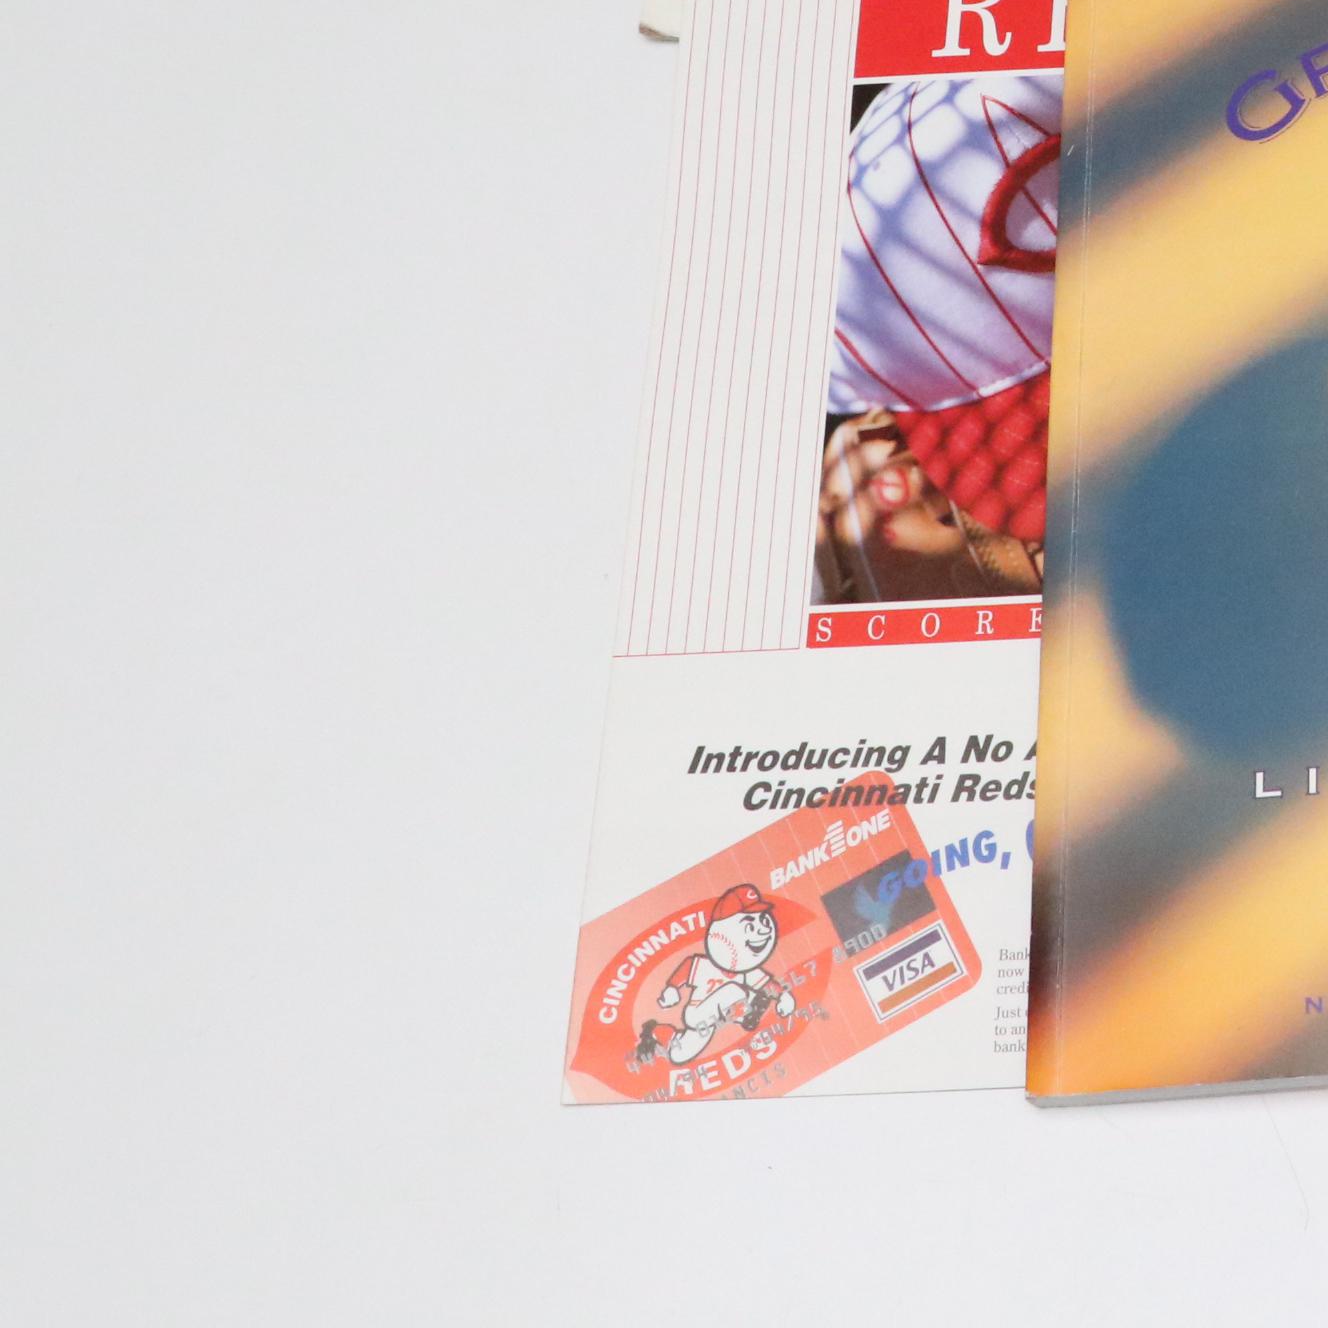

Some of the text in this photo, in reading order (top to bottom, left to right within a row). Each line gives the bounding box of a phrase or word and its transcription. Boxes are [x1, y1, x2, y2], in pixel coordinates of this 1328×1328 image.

[688, 734, 1013, 774] Introducing A No
[742, 774, 940, 811] Cincinnati
[769, 810, 892, 889] BANK ONE
[876, 830, 1012, 904] GOING,
[598, 910, 706, 1024] CINCINNATI
[880, 952, 938, 994] VISA
[668, 1040, 778, 1096] REDS
